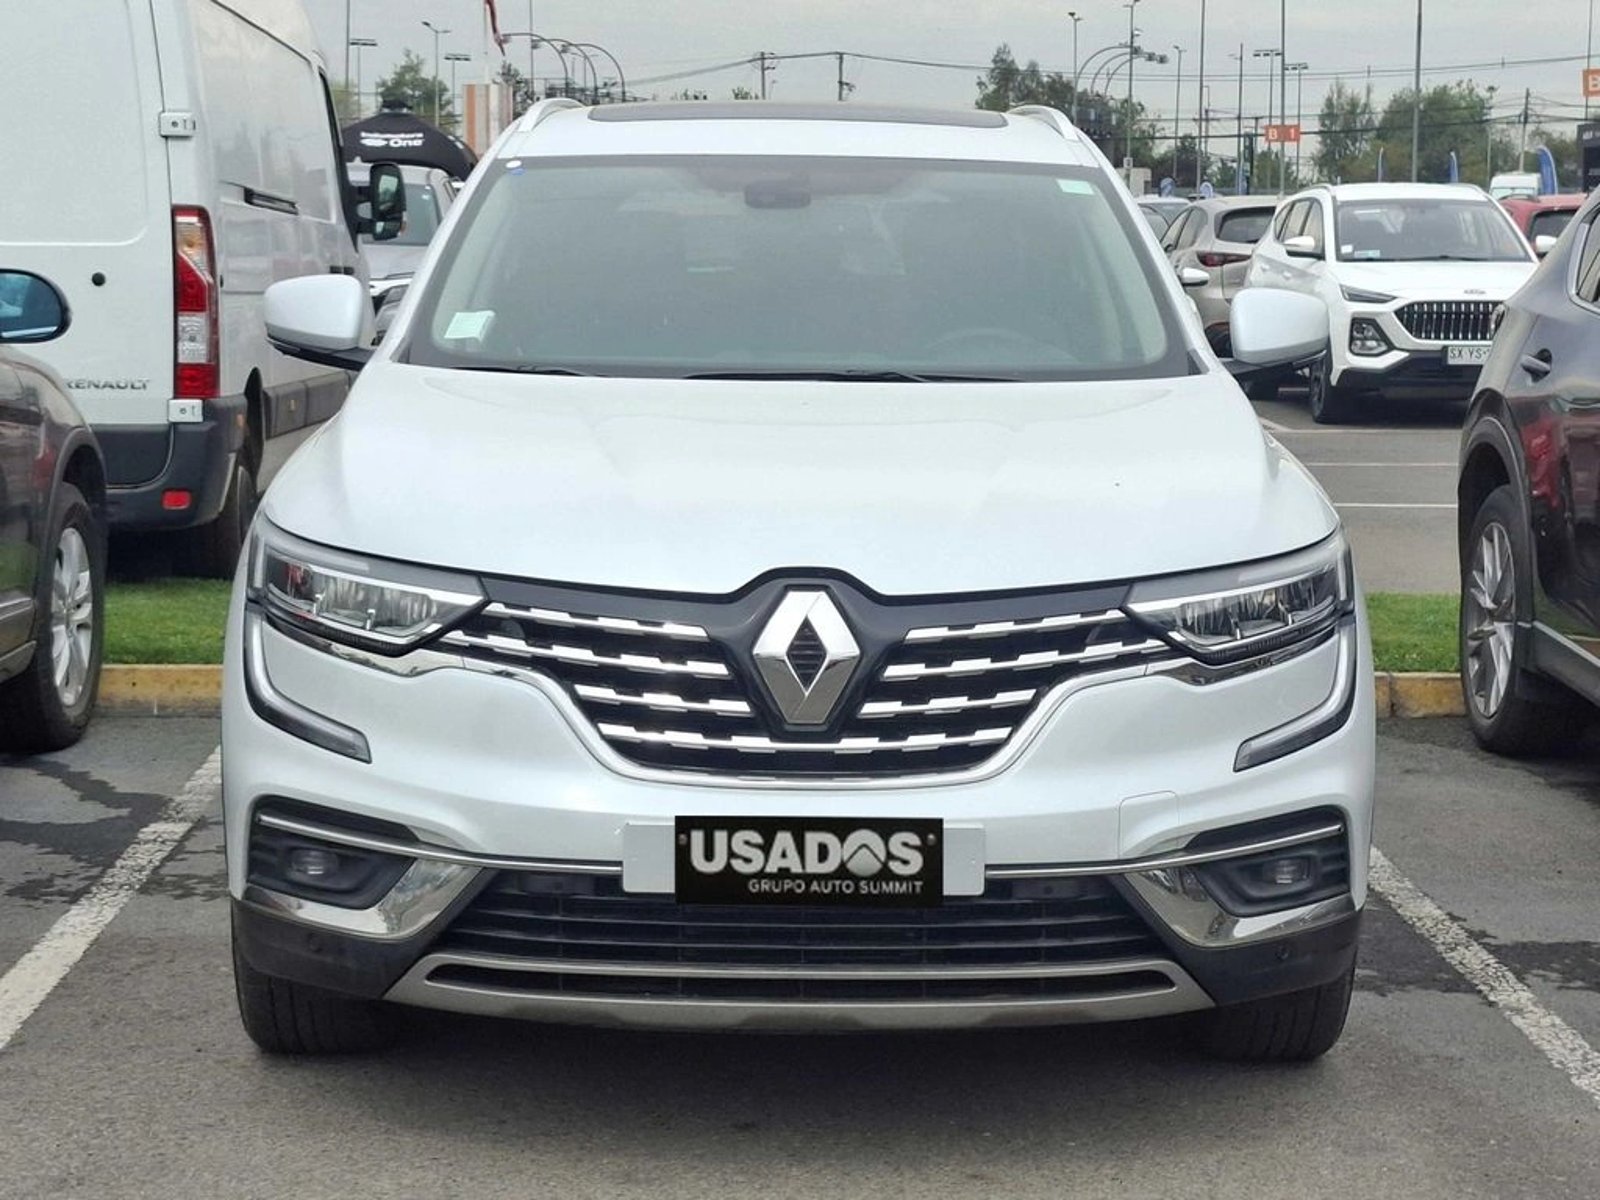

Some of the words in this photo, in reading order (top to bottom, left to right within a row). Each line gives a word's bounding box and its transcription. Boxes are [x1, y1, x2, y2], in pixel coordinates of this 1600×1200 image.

[690, 828, 924, 876] USADOS
[748, 879, 806, 894] GRUPO
[810, 879, 855, 894] AUTO
[859, 880, 923, 894] SUMMIT
